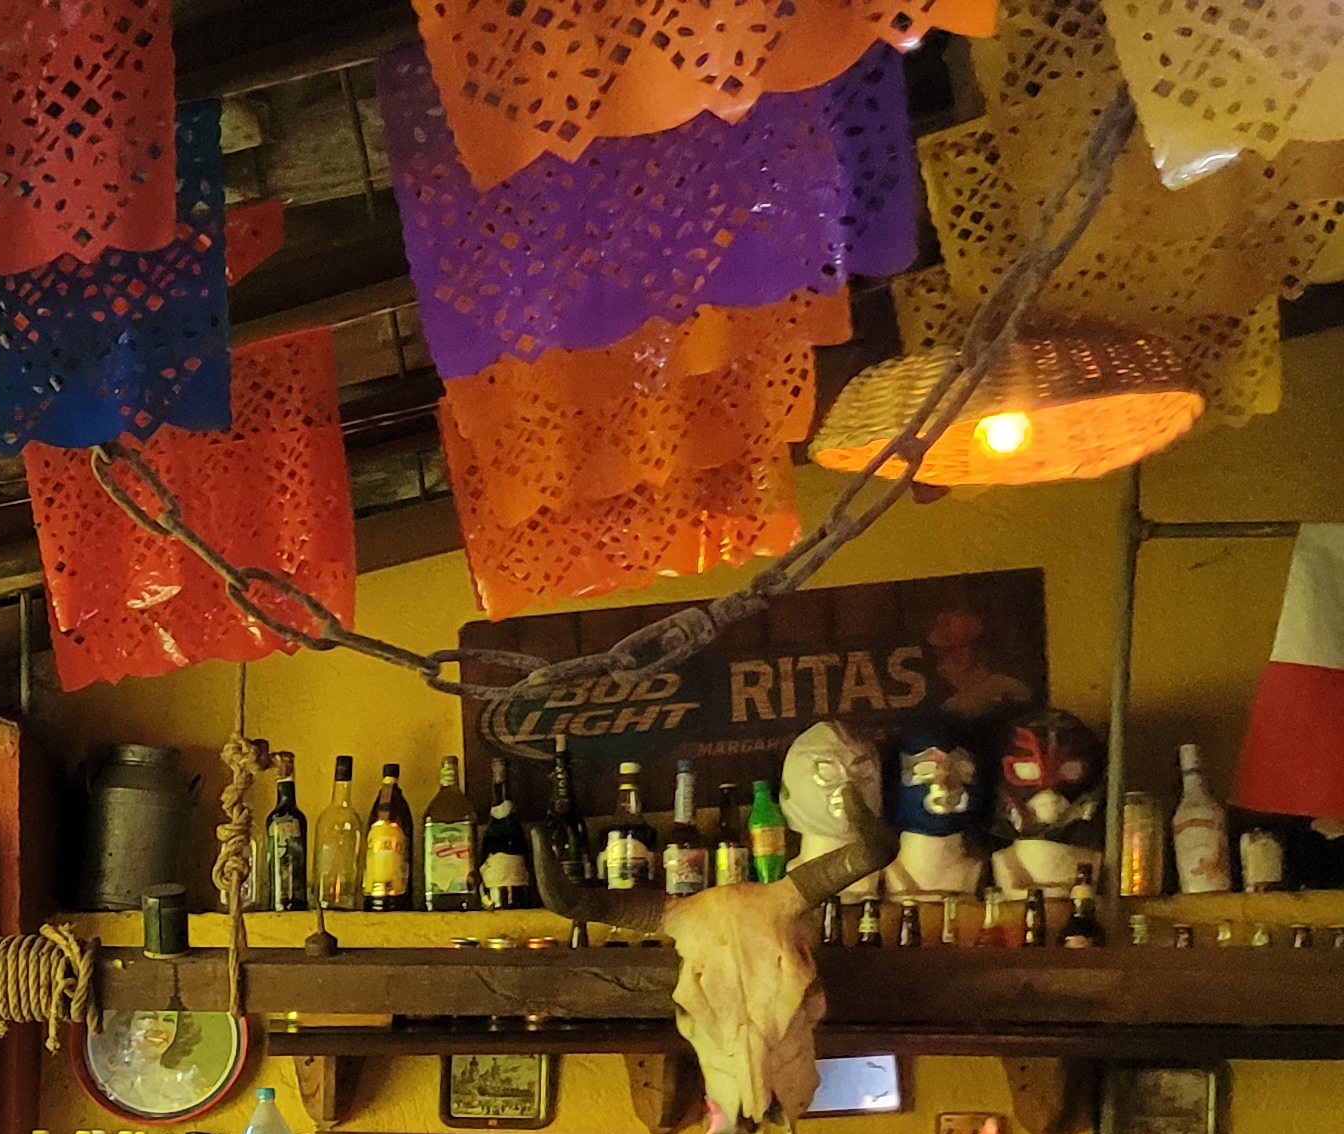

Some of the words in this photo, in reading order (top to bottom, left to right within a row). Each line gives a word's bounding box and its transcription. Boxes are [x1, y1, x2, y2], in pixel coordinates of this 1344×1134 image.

[544, 672, 681, 709] BUD
[730, 646, 926, 722] RITAS
[500, 702, 701, 744] LIGHT
